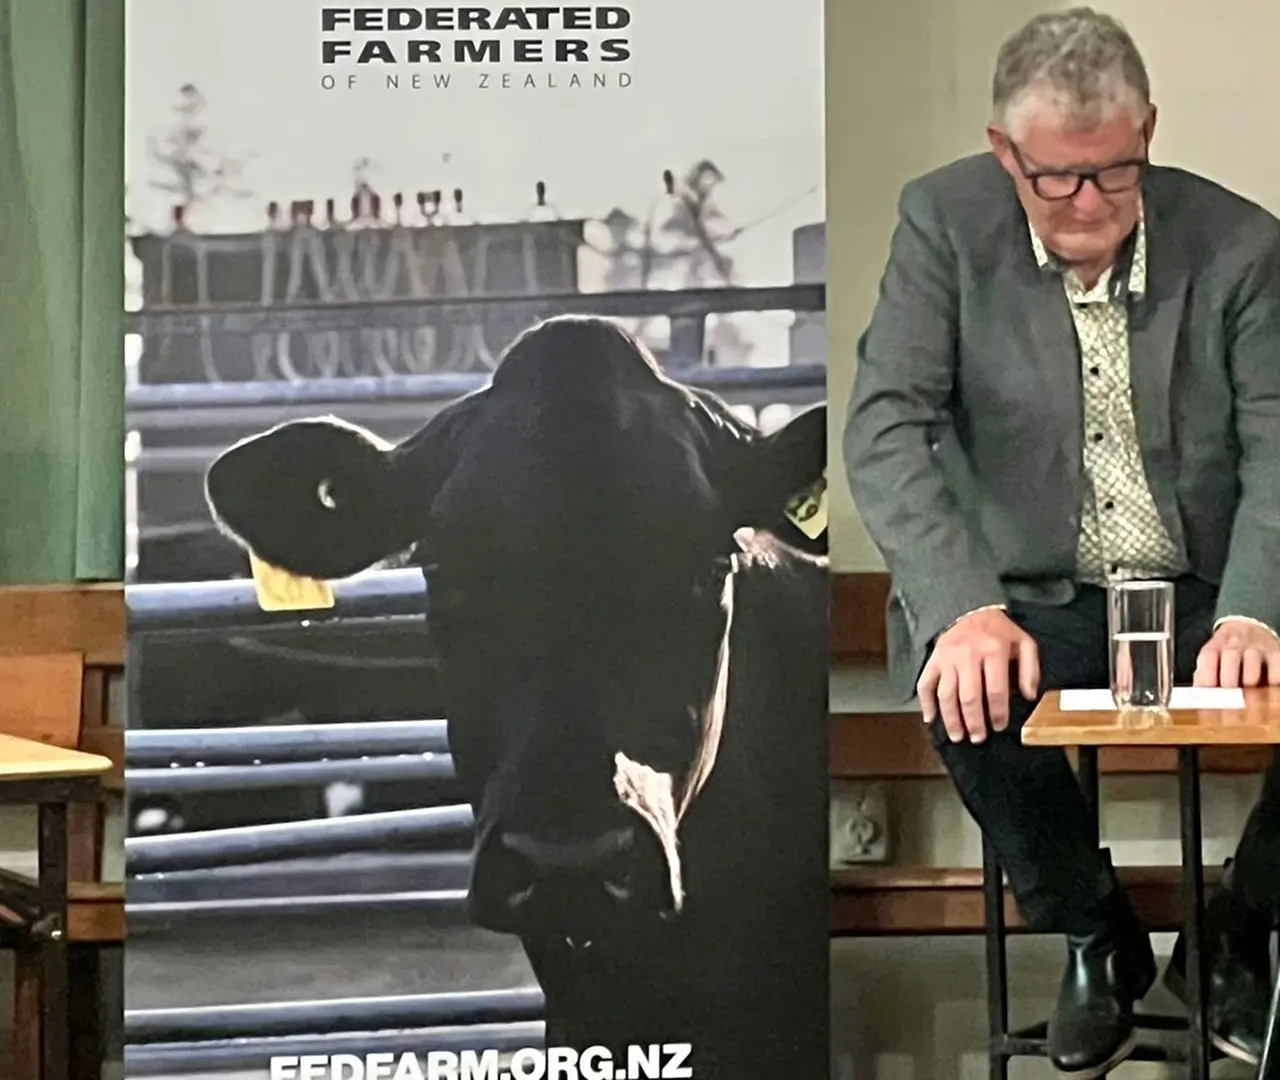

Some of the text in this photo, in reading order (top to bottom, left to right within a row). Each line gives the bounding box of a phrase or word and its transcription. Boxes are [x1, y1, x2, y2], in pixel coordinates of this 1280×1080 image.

[320, 5, 631, 31] FEDERATED
[320, 38, 631, 63] FARMERS
[320, 72, 632, 90] OF NEW ZEALAND
[269, 1043, 694, 1080] FEDFARM.ORG.NZ
